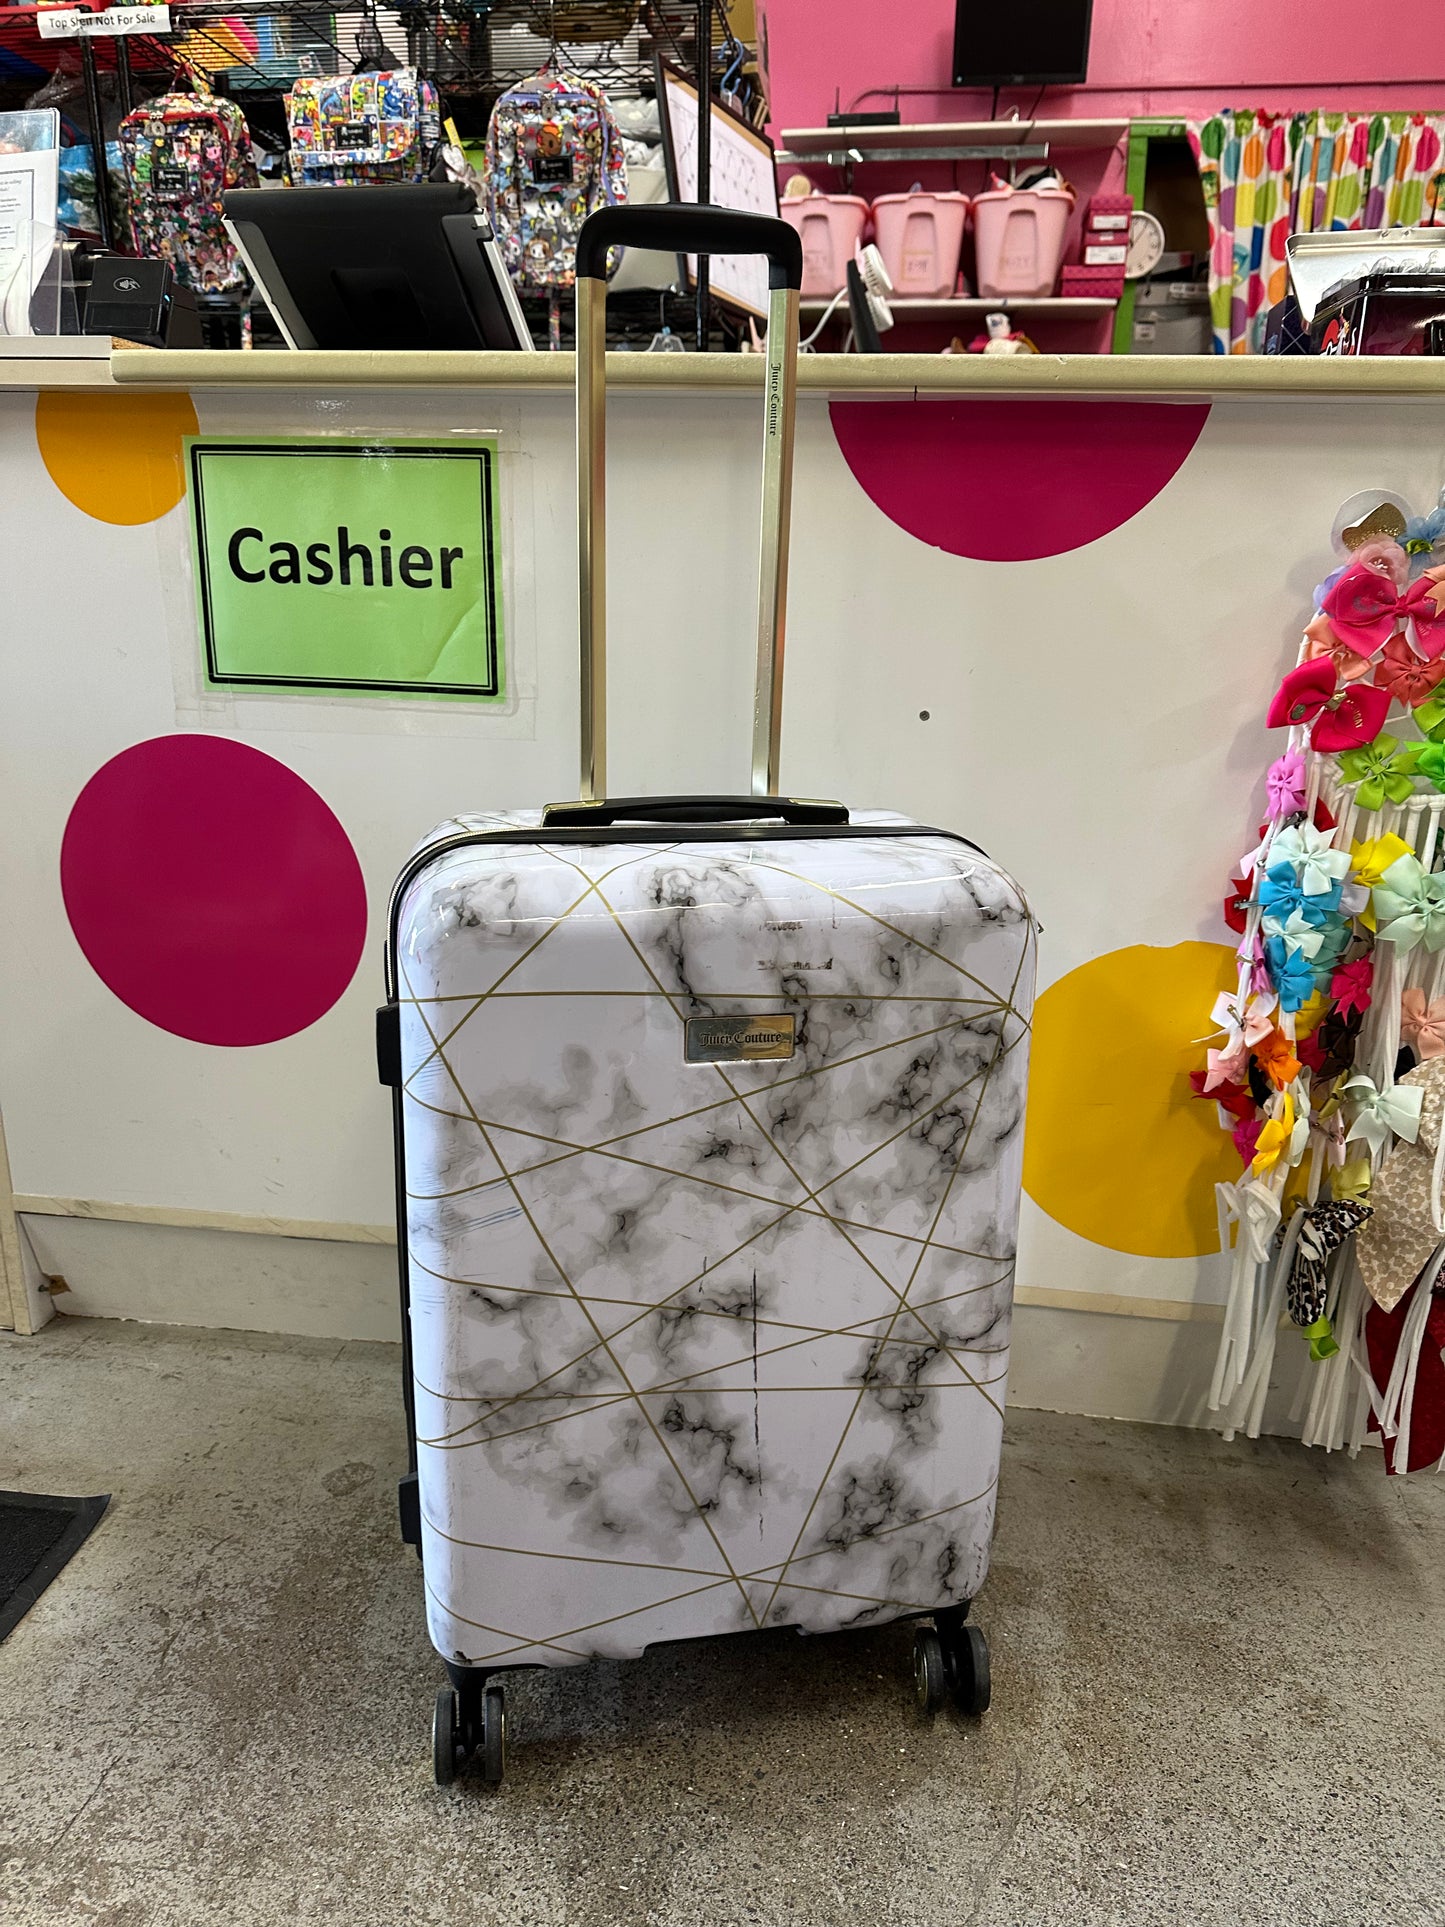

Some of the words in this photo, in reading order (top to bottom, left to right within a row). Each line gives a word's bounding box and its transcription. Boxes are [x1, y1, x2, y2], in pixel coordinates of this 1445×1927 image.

[49, 17, 68, 30] Top
[95, 16, 115, 26] Not
[117, 14, 133, 25] For
[136, 12, 156, 24] Sale
[770, 362, 782, 392] Juicy
[769, 393, 780, 436] Couture
[228, 526, 464, 590] Cashier
[700, 1032, 732, 1048] Juicy
[733, 1030, 782, 1045] Couture
